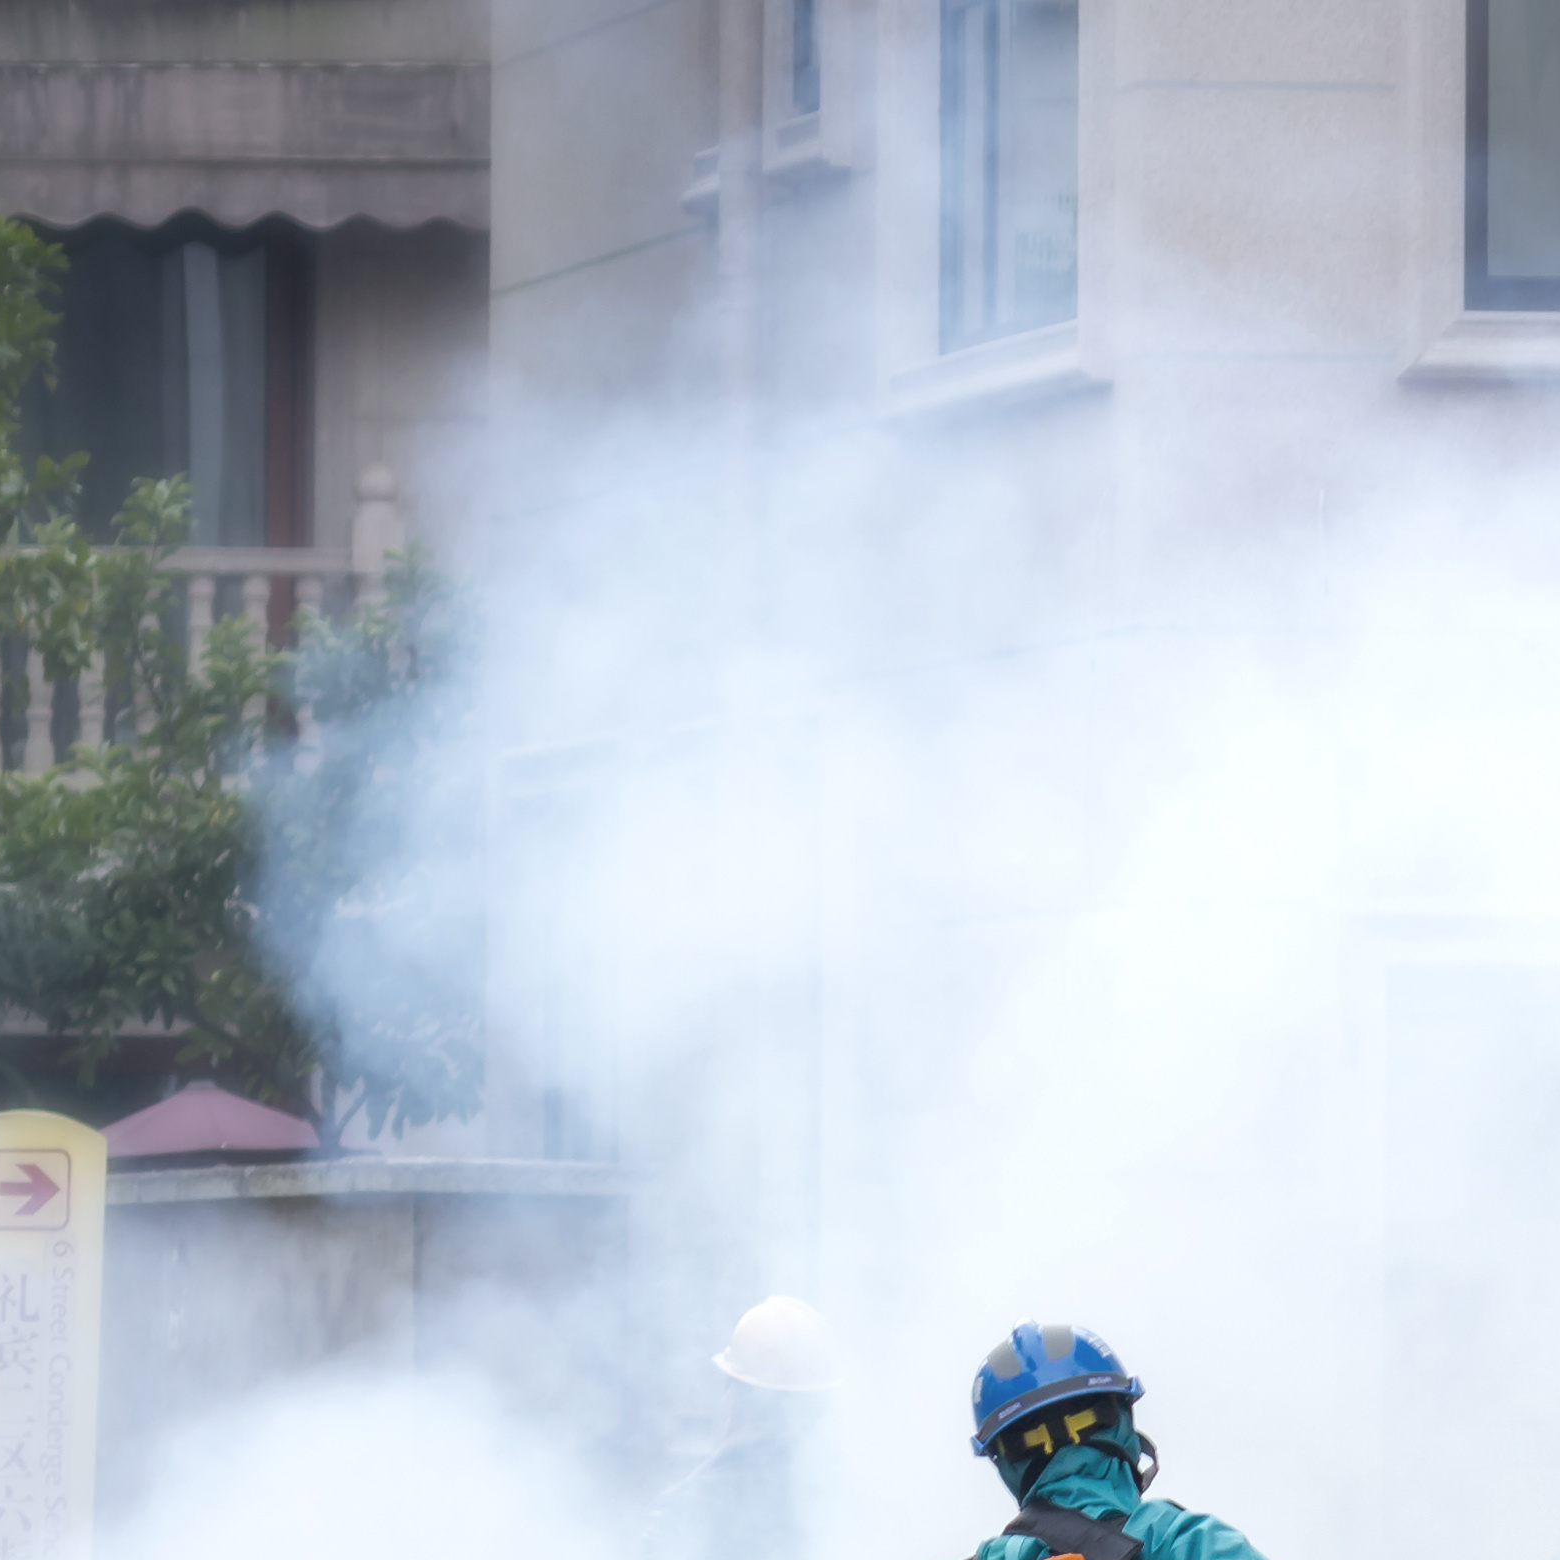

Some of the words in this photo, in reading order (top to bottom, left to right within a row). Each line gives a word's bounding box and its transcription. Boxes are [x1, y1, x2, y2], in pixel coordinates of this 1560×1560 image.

[53, 1240, 75, 1258] 6
[50, 1267, 74, 1344] Street
[39, 1354, 71, 1487] Concierge
